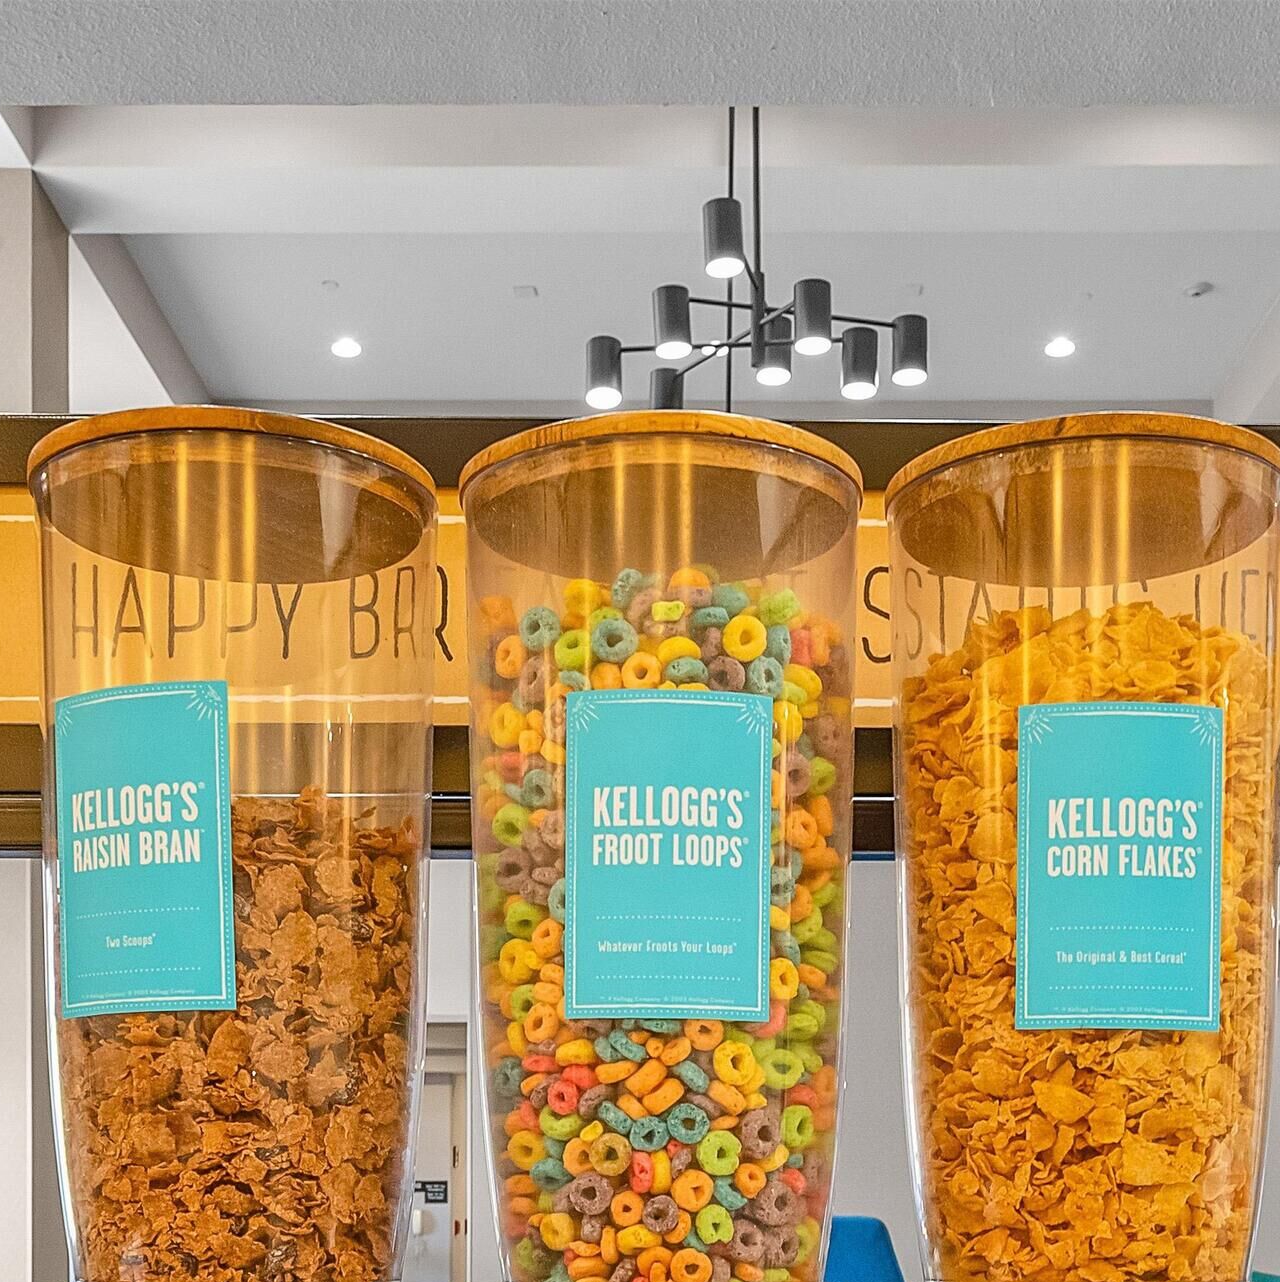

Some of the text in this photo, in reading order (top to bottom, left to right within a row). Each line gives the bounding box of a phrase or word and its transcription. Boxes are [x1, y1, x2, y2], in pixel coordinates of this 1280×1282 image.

[70, 561, 304, 661] HAPPY
[72, 781, 199, 833] KELLOGG'S
[593, 785, 744, 831] KELLOGG'S
[1048, 797, 1198, 841] KELLOGG'S
[73, 829, 201, 873] RAISIN BRAN
[592, 833, 743, 868] FROOT LOOPS
[1047, 844, 1197, 879] CORN FLAKES
[105, 935, 153, 948] Two Scoops
[597, 940, 734, 956] Whatever Froots Your Loops
[1056, 951, 1184, 965] The Original & Best Cereal
